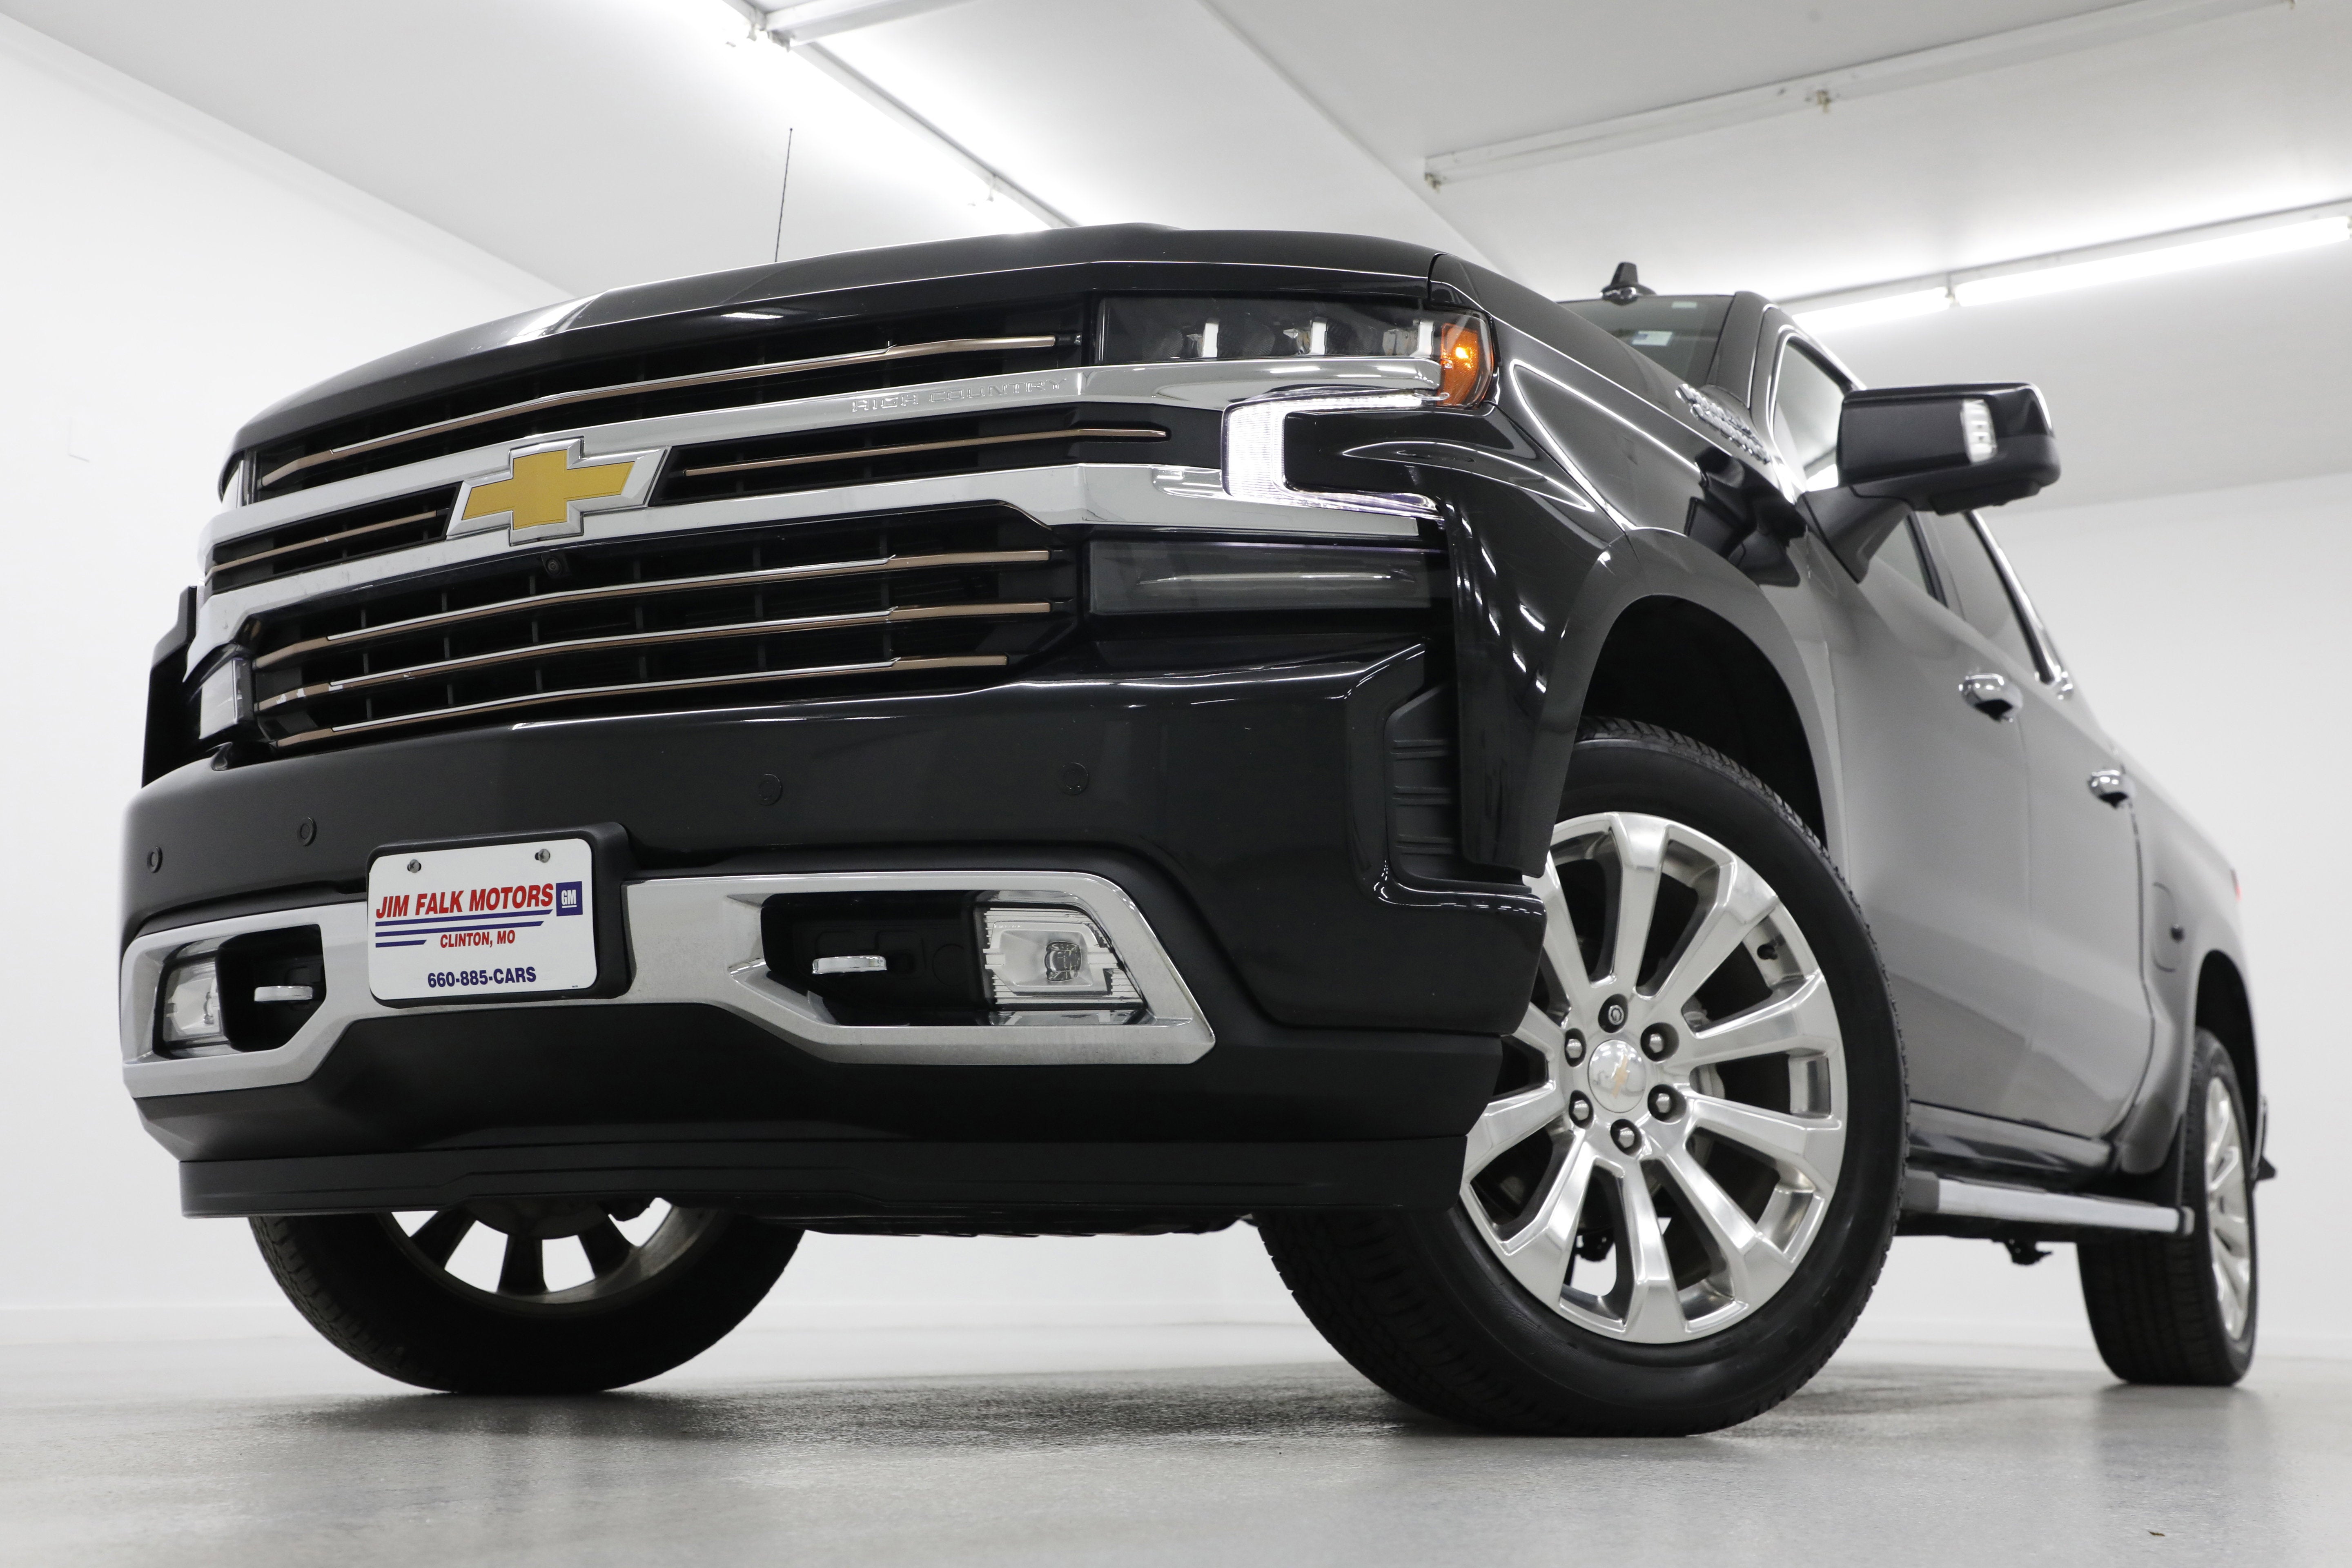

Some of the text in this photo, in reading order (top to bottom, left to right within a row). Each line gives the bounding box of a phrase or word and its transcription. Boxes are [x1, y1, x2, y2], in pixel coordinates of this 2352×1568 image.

[852, 378, 1067, 412] HIGH COUNTRY
[376, 883, 554, 919] JIM FALK MOTORS
[561, 889, 577, 905] GM
[440, 930, 515, 948] CLINTON, MO
[427, 966, 537, 988] 660-885-CARS
